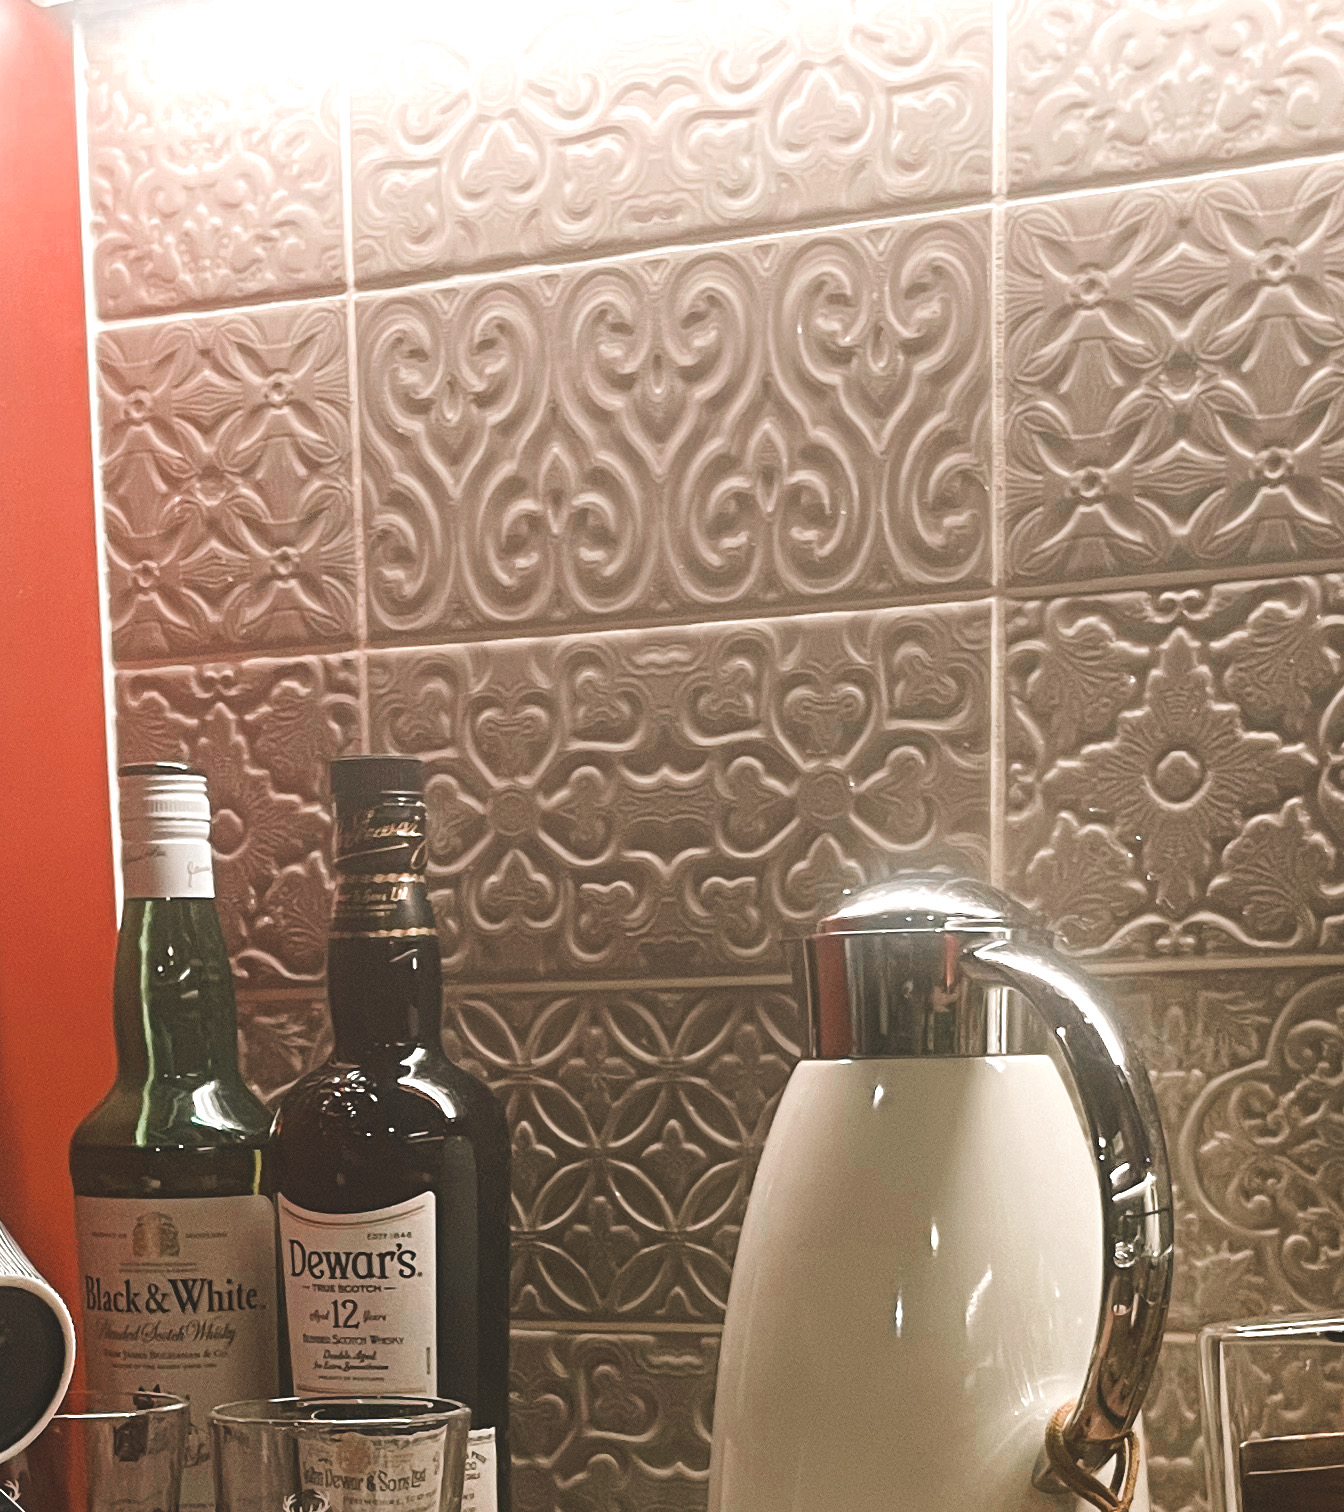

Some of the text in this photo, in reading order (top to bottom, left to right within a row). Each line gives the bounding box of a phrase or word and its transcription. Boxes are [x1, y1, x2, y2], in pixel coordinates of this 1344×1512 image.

[289, 1239, 417, 1280] Dewar's
[312, 1284, 382, 1294] TRUE SCOTCH
[331, 1299, 360, 1329] 12
